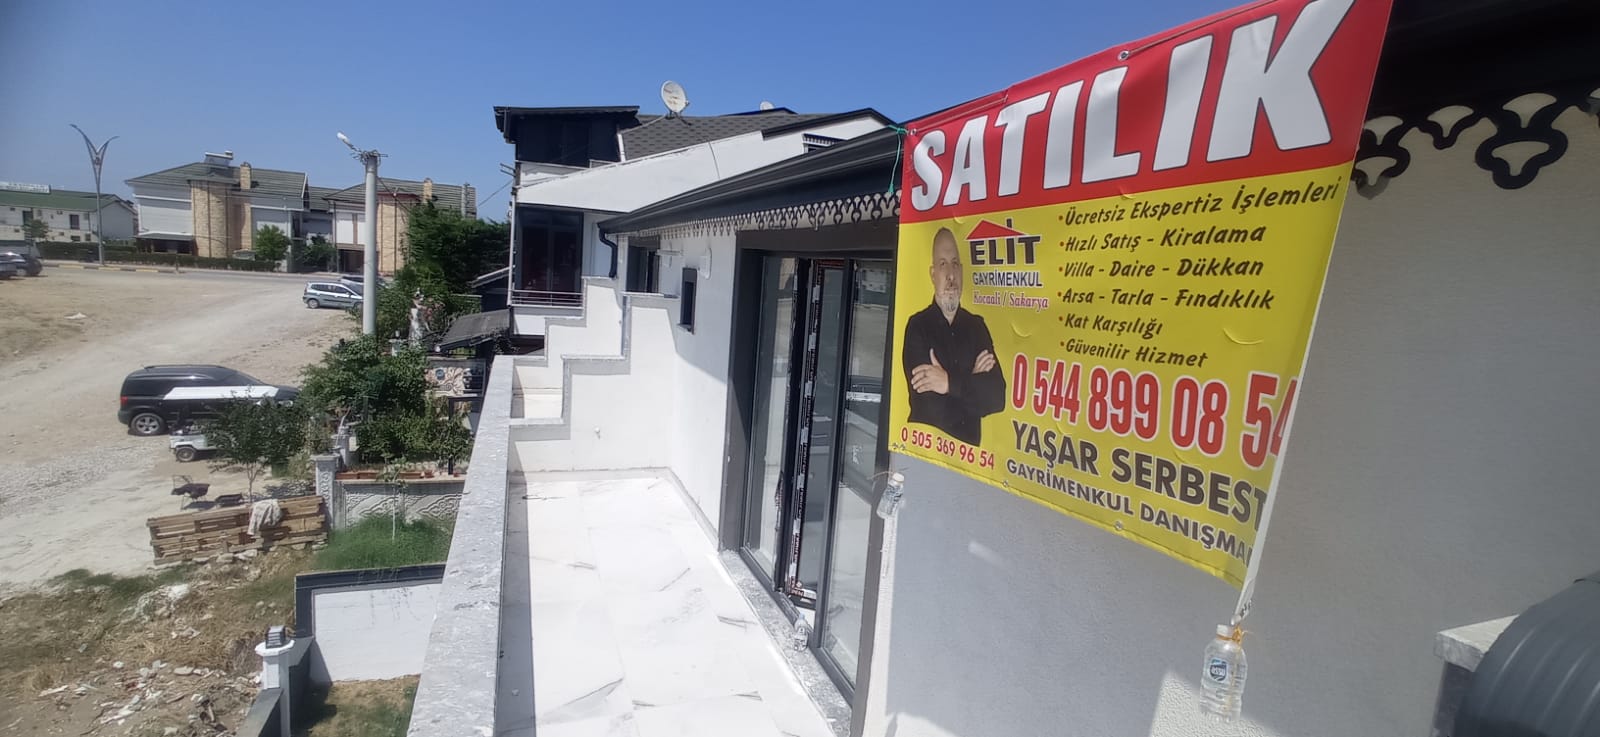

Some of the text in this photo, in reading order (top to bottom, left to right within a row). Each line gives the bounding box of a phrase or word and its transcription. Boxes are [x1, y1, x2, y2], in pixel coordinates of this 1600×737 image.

[910, 0, 1355, 212] SATILIK
[1065, 176, 1341, 226] Ücretsiz Ekspertiz İşlemleri
[1065, 236, 1097, 252] Hızlı
[1100, 233, 1140, 252] Satış
[1160, 224, 1266, 247] Kiralama
[972, 270, 1042, 287] GAYRİMENKUL
[1064, 262, 1094, 277] Villa
[1109, 261, 1155, 277] Daire
[1176, 258, 1264, 277] Dükkan
[973, 291, 1001, 306] Kocaali
[1009, 293, 1048, 311] Sakarya
[1062, 289, 1093, 303] Arsa
[1110, 288, 1152, 306] Tarla
[1174, 288, 1275, 310] Fındıklık
[1064, 313, 1163, 338] Kat Karşılığı
[1065, 339, 1209, 368] Güvenilir Hizmet
[1012, 354, 1028, 409] 0
[1033, 360, 1080, 425] 544
[1088, 368, 1159, 440] 899
[1172, 377, 1228, 455] 08
[901, 426, 994, 469] 0 505 369 96 54
[1012, 421, 1099, 475] YAŞAR
[1007, 459, 1134, 515] GAYRİMENKUL
